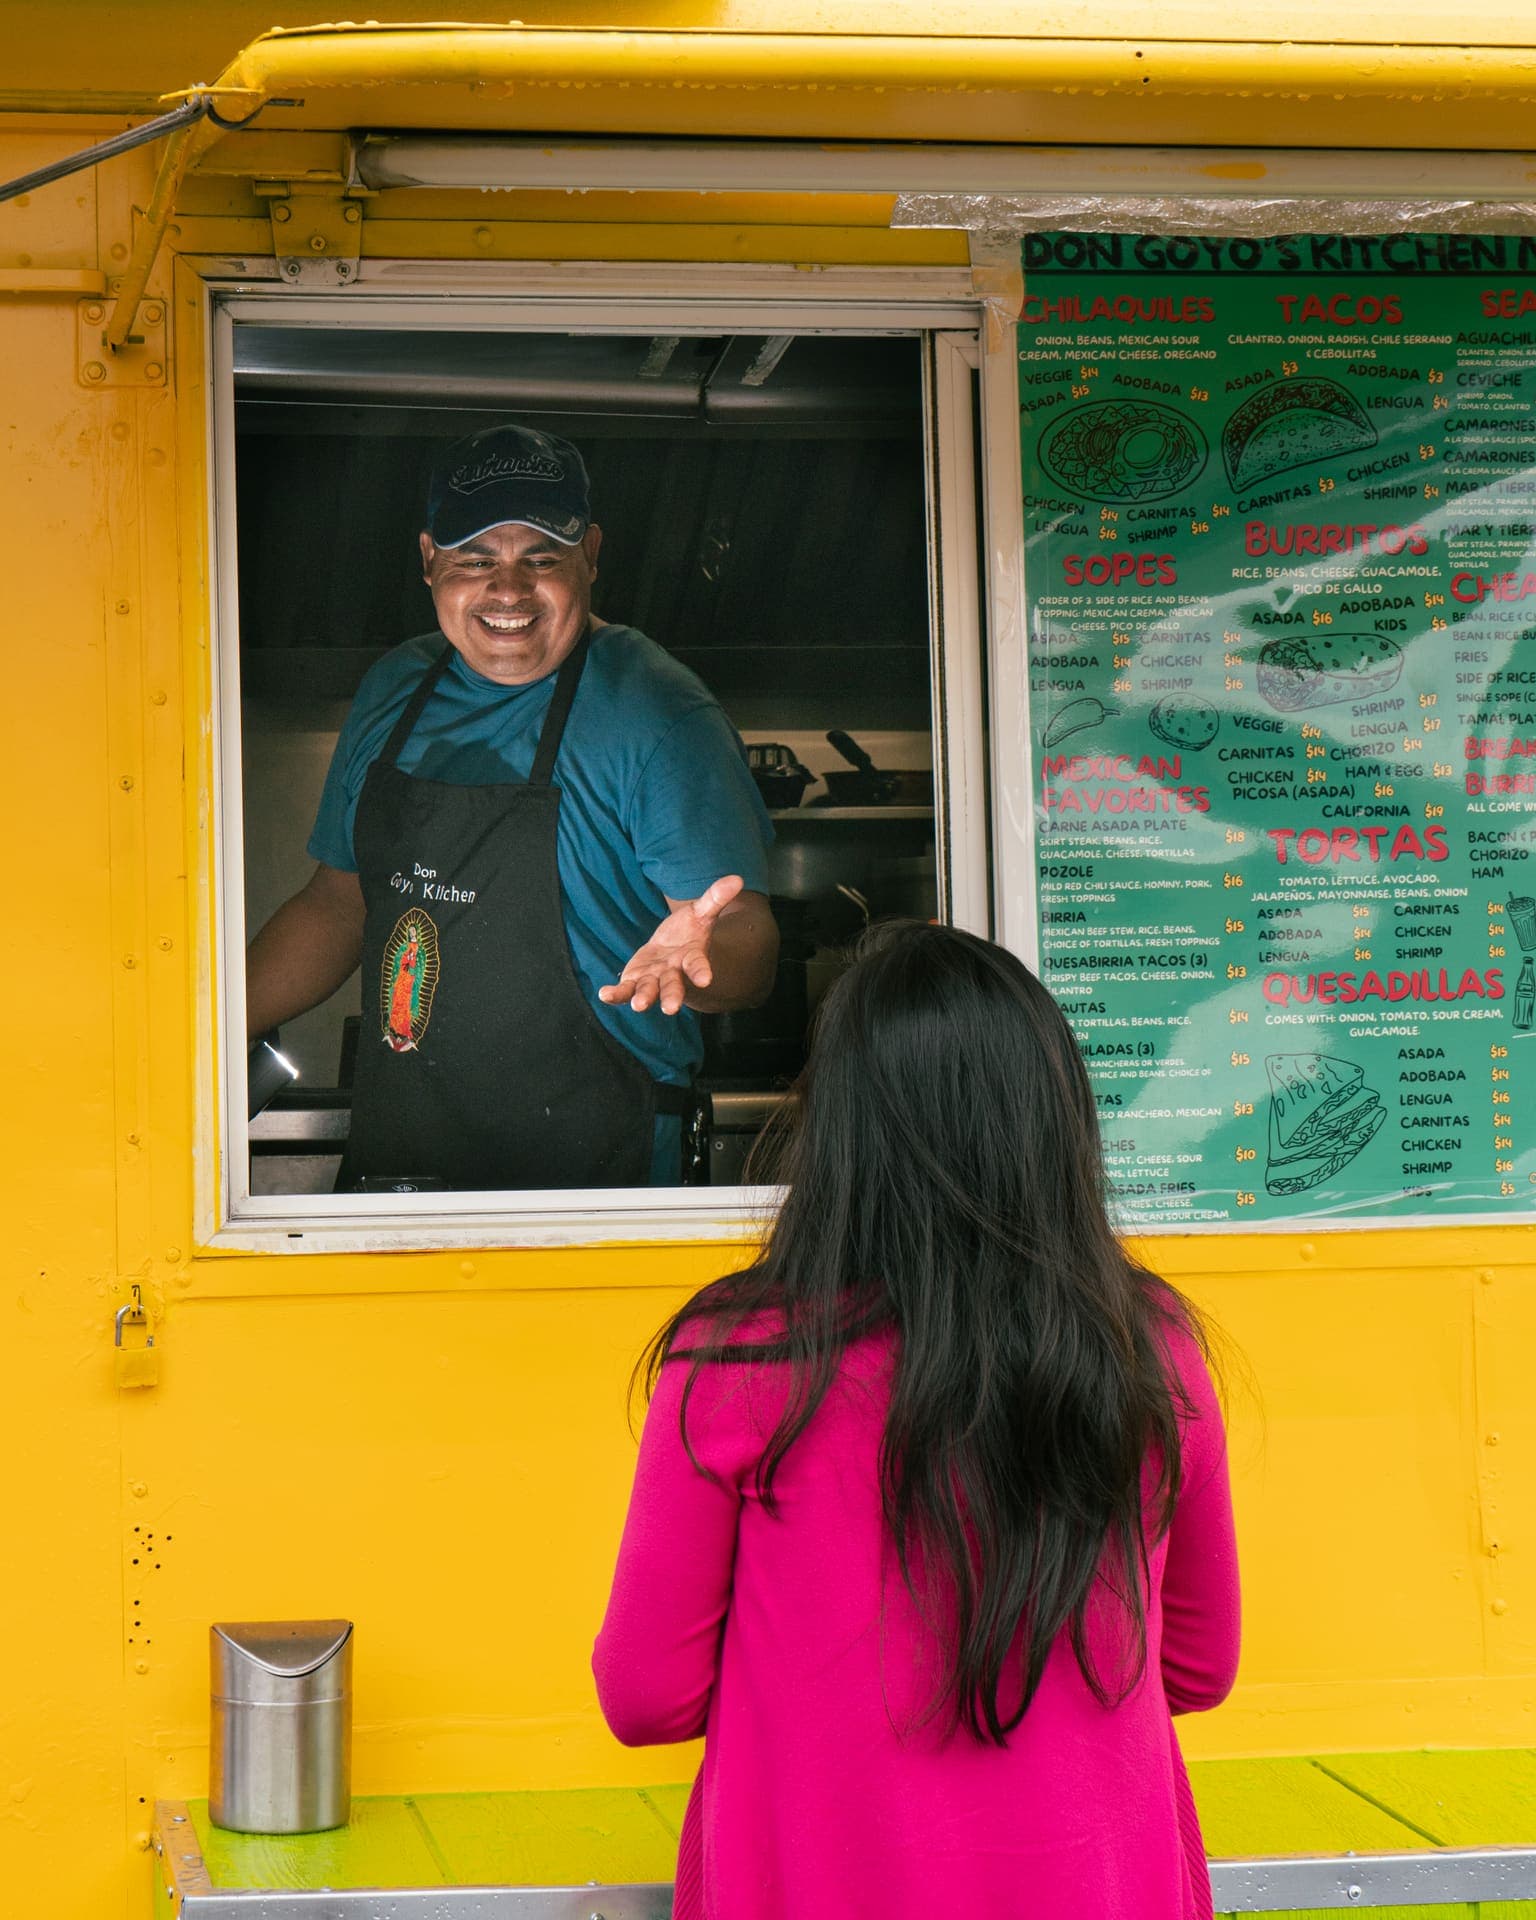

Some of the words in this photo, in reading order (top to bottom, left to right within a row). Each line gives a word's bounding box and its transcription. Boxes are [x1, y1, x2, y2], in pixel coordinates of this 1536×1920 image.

[1024, 235, 1122, 267] DON
[1134, 236, 1301, 270] GOYO'S
[1310, 235, 1506, 270] KITCHEN
[1021, 295, 1216, 325] CHILAQUILES
[1276, 293, 1404, 326] TACOS
[1118, 335, 1170, 345] MEXICAN
[1172, 336, 1199, 345] SOUR
[1371, 335, 1401, 344] CHILE
[1404, 335, 1452, 344] SERRANO
[1065, 351, 1116, 360] MEXICAN
[1164, 351, 1217, 359] OREGANO
[1314, 349, 1376, 359] CEBOLLITAS
[1025, 370, 1073, 385] VEGGIE
[1080, 365, 1099, 380] $14
[1225, 369, 1275, 393] ASADA
[1282, 361, 1299, 376] $3
[1347, 364, 1421, 380] ADOBADA
[1428, 369, 1444, 384] $3
[1457, 373, 1523, 386] CEVICHE
[1113, 374, 1181, 396] ADOBADA
[1190, 387, 1208, 401] $13
[1021, 392, 1066, 413] ASADA
[1071, 385, 1090, 400] $15
[1367, 395, 1424, 409] LENGUA
[1433, 394, 1449, 410] $4
[1347, 453, 1410, 482] CHICKEN
[1419, 445, 1435, 461] $3
[1237, 484, 1312, 514] CARNITAS
[1319, 478, 1335, 494] $3
[1364, 486, 1417, 501] SHRIMP
[1424, 484, 1439, 500] $4
[1023, 495, 1085, 515] CHICKEN
[1100, 506, 1118, 522] $14
[1127, 507, 1197, 521] CARNITAS
[1212, 504, 1230, 519] $14
[1035, 520, 1089, 536] LENGUA
[1099, 526, 1117, 541] $16
[1128, 526, 1177, 544] SHRIMP
[1191, 521, 1209, 535] $16
[1245, 520, 1429, 557] BURRITOS
[1062, 552, 1178, 587] SOPES
[1293, 584, 1321, 595] PICO
[1325, 584, 1339, 594] DE
[1343, 583, 1382, 594] GALLO
[1039, 597, 1069, 605] ORDER
[1118, 596, 1129, 604] OF
[1131, 596, 1152, 604] RICE
[1155, 596, 1175, 604] AND
[1340, 596, 1415, 614] ADOBADA
[1424, 594, 1444, 609] $14
[1083, 609, 1127, 617] MEXICAN
[1252, 612, 1305, 625] ASADA
[1312, 610, 1333, 626] $16
[1110, 622, 1134, 630] PICO
[1136, 622, 1147, 630] DE
[1149, 622, 1180, 630] GALLO
[1374, 619, 1407, 631] KIDS
[1432, 617, 1448, 632] $5
[1031, 633, 1078, 644] ASADA
[1112, 632, 1130, 646] $15
[1139, 632, 1211, 644] CARNITAS
[1223, 631, 1241, 644] $14
[1031, 656, 1100, 668] ADOBADA
[1113, 655, 1131, 669] $14
[1140, 656, 1202, 668] CHICKEN
[1224, 653, 1243, 668] $14
[1455, 652, 1488, 663] FRIES
[1032, 680, 1085, 691] LENGUA
[1114, 677, 1132, 692] $16
[1140, 678, 1193, 691] SHRIMP
[1224, 679, 1243, 691] $16
[1352, 698, 1405, 717] SHRIMP
[1419, 694, 1438, 708] $17
[1233, 715, 1284, 734] VEGGIE
[1302, 724, 1322, 740] $14
[1351, 721, 1408, 738] LENGUA
[1423, 717, 1441, 733] $17
[1218, 747, 1295, 762] CARNITAS
[1306, 743, 1325, 758] $14
[1330, 742, 1396, 761] CHORIZO
[1404, 738, 1422, 752] $14
[1041, 754, 1182, 781] MEXICAN
[1345, 765, 1380, 778] HAM
[1394, 766, 1424, 777] EGG
[1433, 763, 1452, 778] $13
[1228, 771, 1294, 784] CHICKEN
[1307, 768, 1327, 783] $14
[1233, 787, 1289, 800] PICOSA
[1292, 785, 1356, 800] (ASADA)
[1374, 783, 1394, 798] $16
[1041, 787, 1211, 814] FAVORITES
[1467, 803, 1486, 812] ALL
[1489, 803, 1521, 812] COME
[1322, 804, 1411, 818] CALIFORNIA
[1425, 801, 1444, 818] $19
[1039, 820, 1087, 833] CARNE
[1092, 820, 1140, 832] ASADA
[1144, 820, 1187, 831] PLATE
[1225, 828, 1245, 843] $18
[1268, 824, 1450, 865] TORTAS
[1145, 849, 1195, 858] TORTILLAS
[1470, 849, 1529, 861] CHORIZO
[414, 863, 437, 879] Don
[1040, 866, 1093, 878] POZOLE
[1223, 873, 1243, 888] $16
[1471, 866, 1504, 879] HAM
[1065, 882, 1082, 890] RED
[1084, 881, 1108, 890] CHILI
[1434, 888, 1468, 896] ONION
[1071, 894, 1116, 903] TOPPINGS
[1257, 909, 1303, 919] ASADA
[1353, 904, 1370, 917] $15
[1394, 905, 1459, 916] CARNITAS
[1488, 901, 1504, 915] $14
[1041, 912, 1086, 923] BIRRIA
[1225, 917, 1245, 934] $15
[1394, 925, 1452, 939] CHICKEN
[1488, 923, 1505, 937] $14
[1258, 929, 1323, 941] ADOBADA
[1354, 925, 1371, 940] $14
[1396, 947, 1443, 959] SHRIMP
[1489, 945, 1506, 958] $16
[1043, 956, 1134, 970] QUESABIRRIA
[1138, 955, 1186, 967] TACOS
[1190, 953, 1208, 968] (3)
[1226, 964, 1246, 979] $13
[1262, 968, 1506, 1008] QUESADILLAS
[1433, 1011, 1460, 1020] SOUR
[1398, 1048, 1445, 1059] ASADA
[1491, 1045, 1508, 1058] $15
[1399, 1070, 1466, 1082] ADOBADA
[1491, 1069, 1509, 1082] $14
[1400, 1094, 1453, 1106] LENGUA
[1492, 1091, 1510, 1104] $16
[1400, 1116, 1470, 1128] CARNITAS
[1493, 1113, 1511, 1128] $14
[1401, 1138, 1462, 1152] CHICKEN
[1494, 1136, 1512, 1150] $14
[1235, 1147, 1256, 1163] $10
[1402, 1161, 1452, 1174] SHRIMP
[1495, 1158, 1513, 1173] $16
